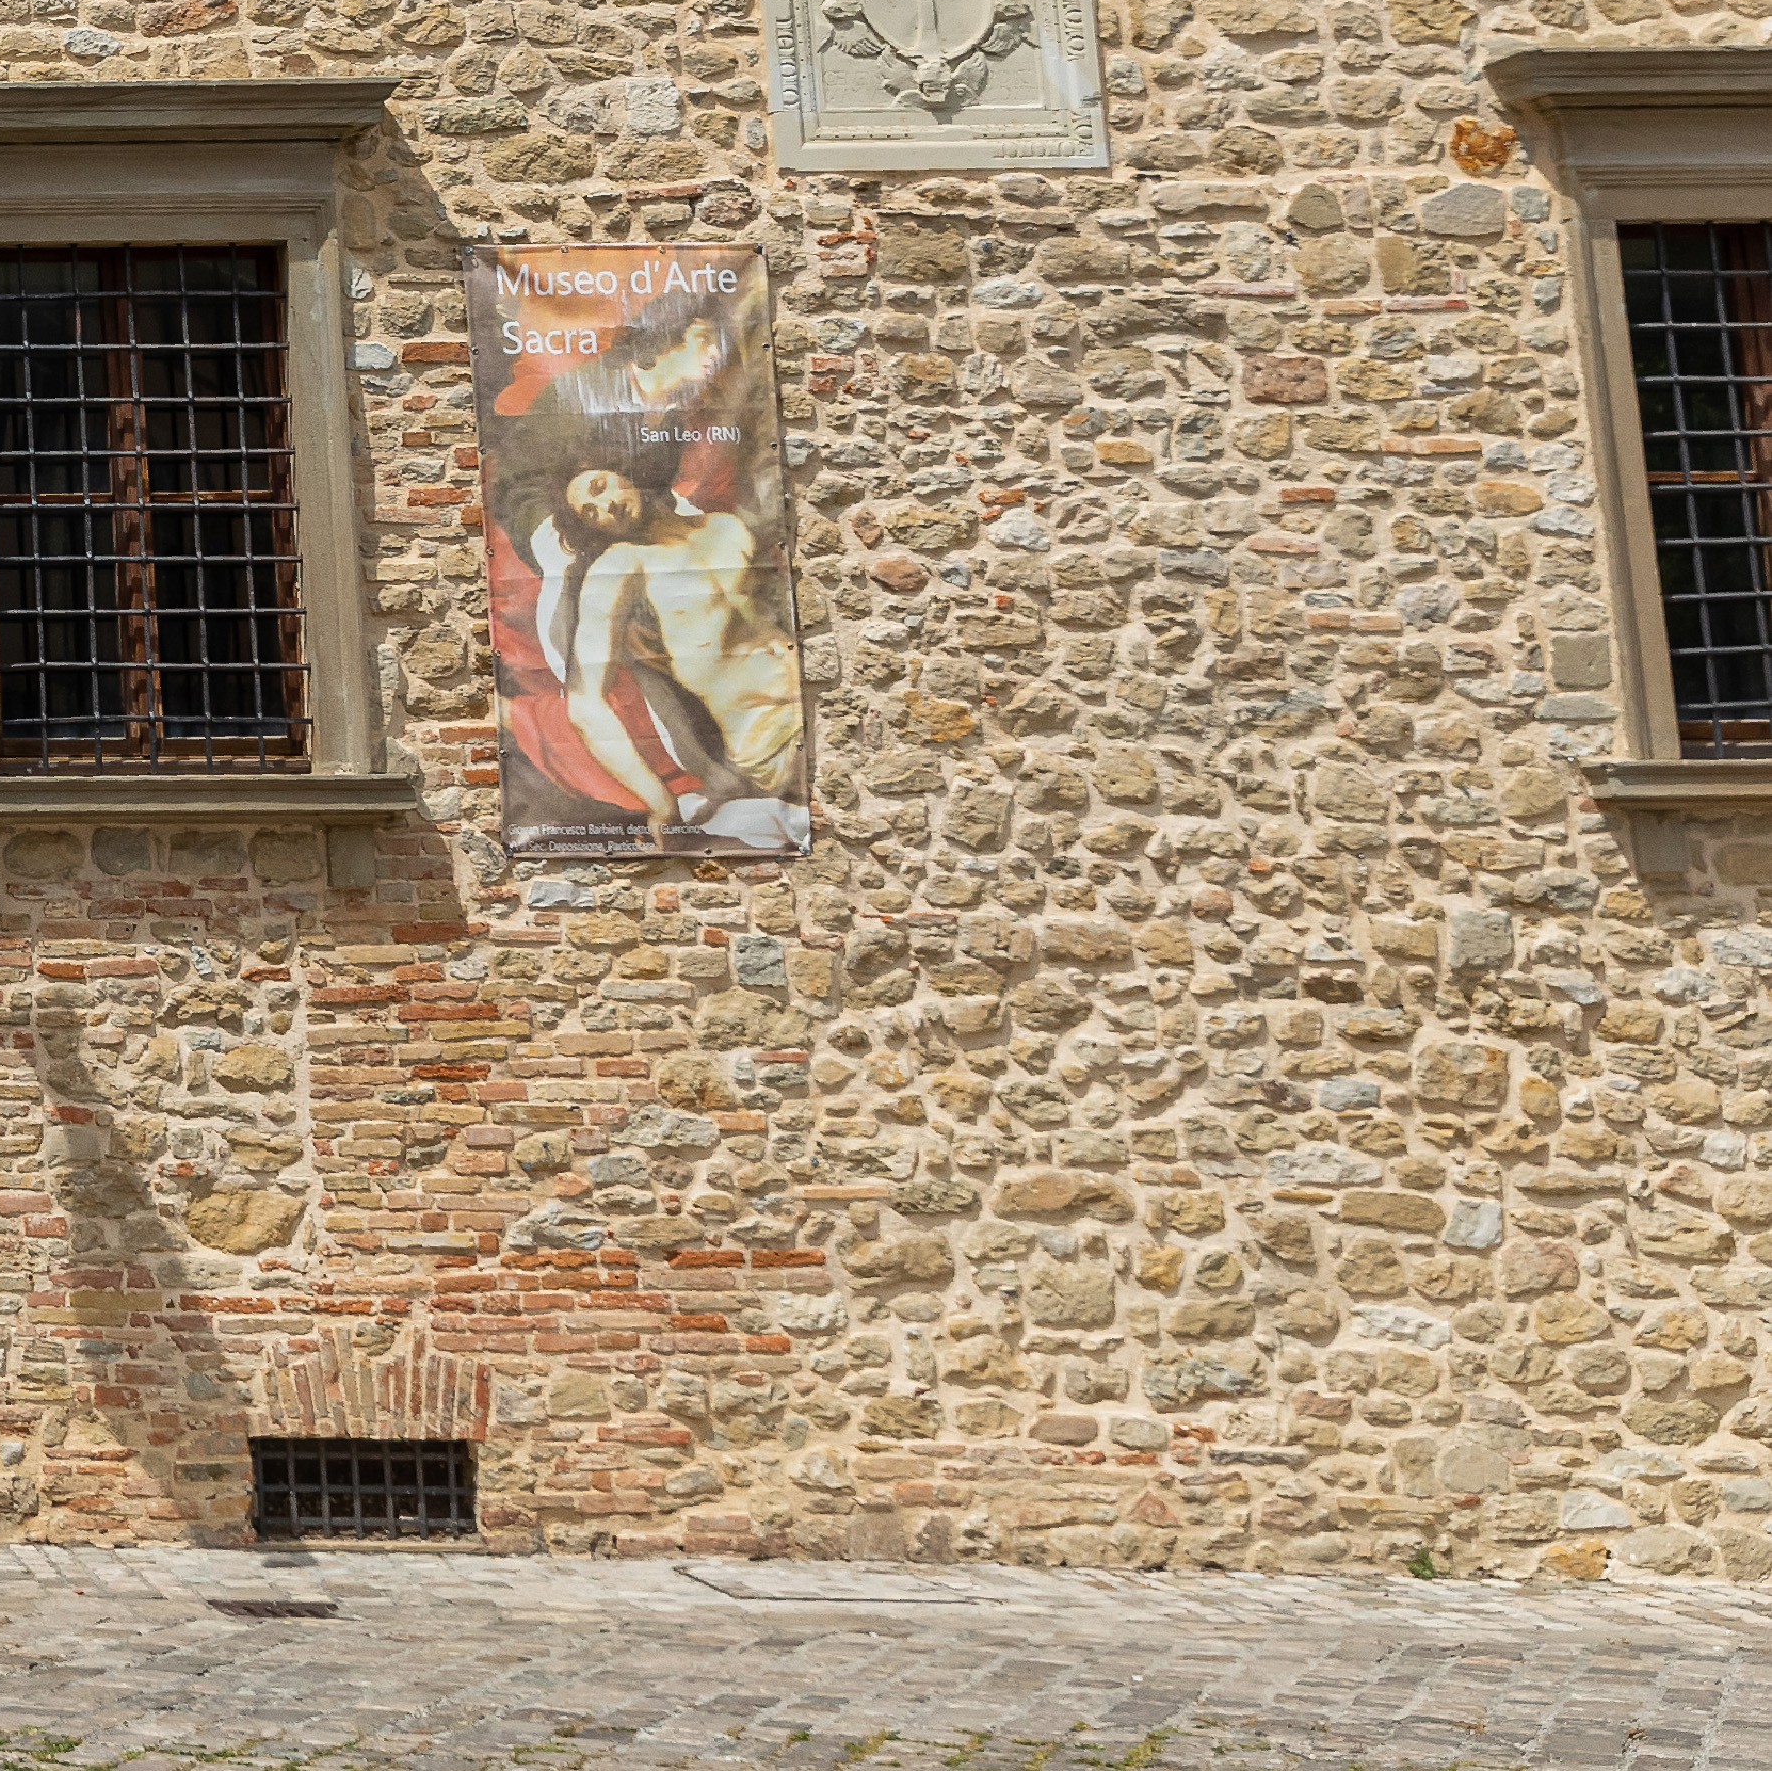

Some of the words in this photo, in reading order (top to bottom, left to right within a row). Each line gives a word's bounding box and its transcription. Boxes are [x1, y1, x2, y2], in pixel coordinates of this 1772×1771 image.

[496, 263, 618, 297] Museo
[629, 260, 739, 295] d'Arte
[501, 322, 598, 356] Sacra
[640, 427, 670, 443] San
[674, 427, 702, 443] Leo
[706, 425, 741, 445] (RN)
[542, 825, 587, 835] Francesco
[588, 823, 625, 835] Barbieri,
[661, 824, 702, 835] Guercino
